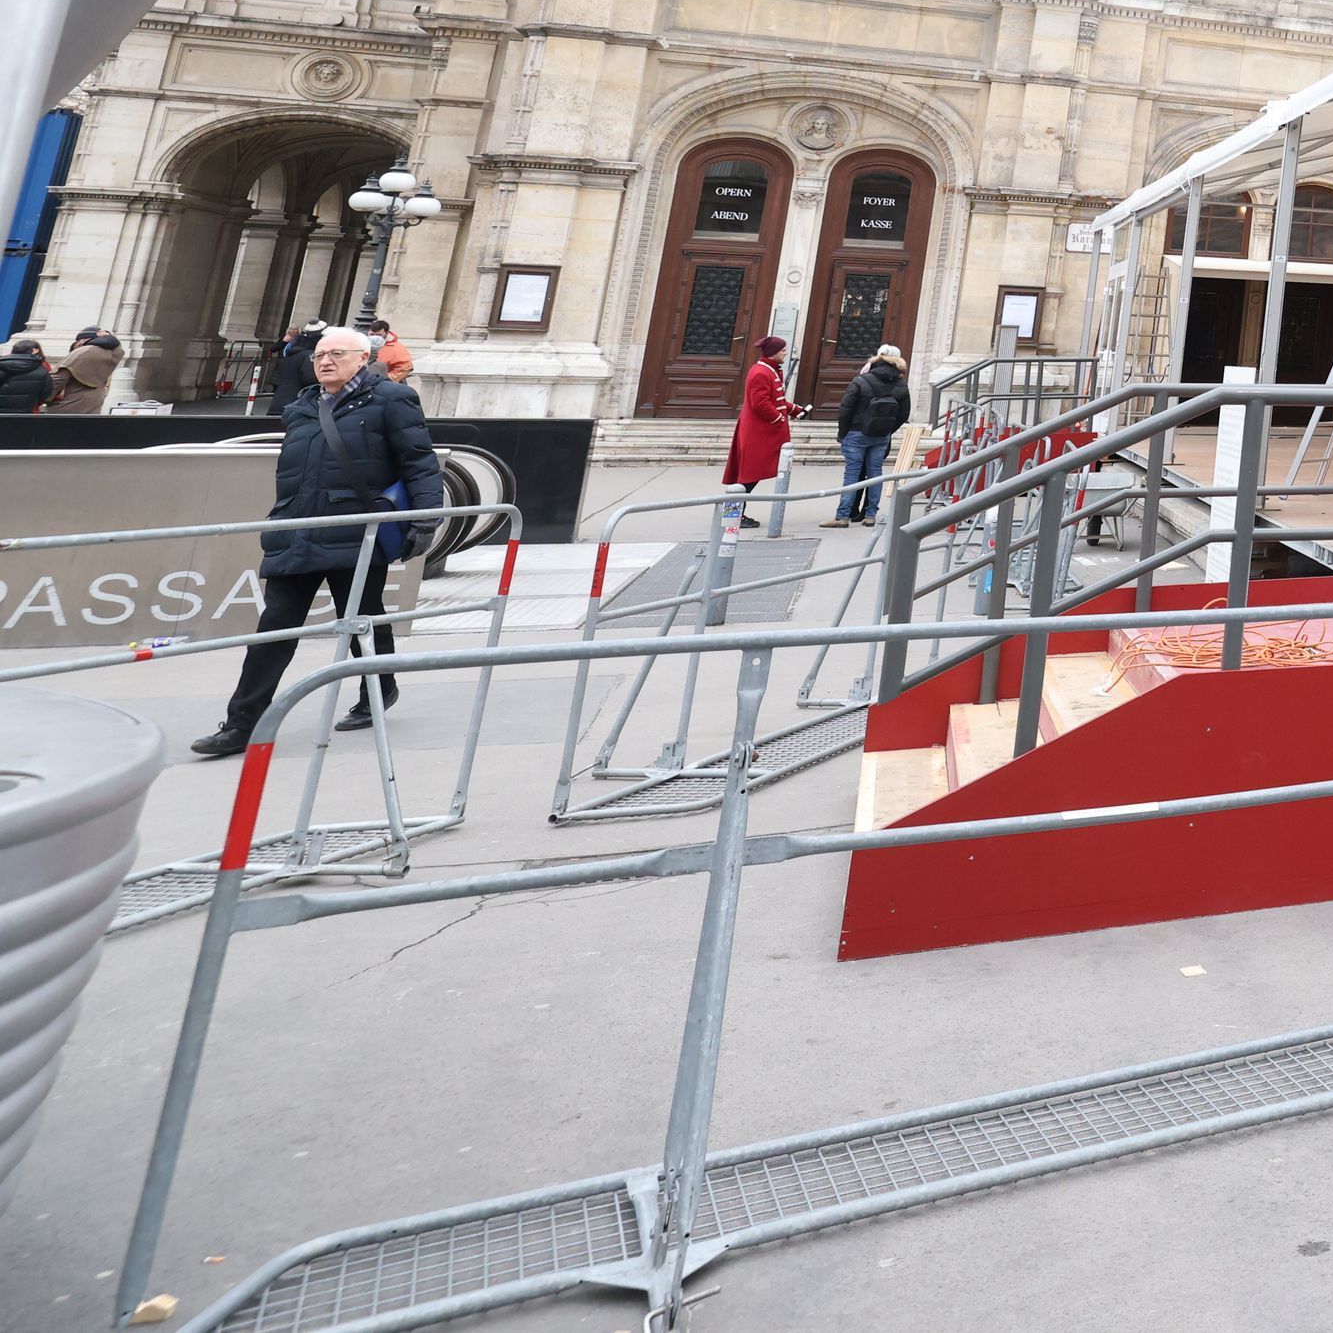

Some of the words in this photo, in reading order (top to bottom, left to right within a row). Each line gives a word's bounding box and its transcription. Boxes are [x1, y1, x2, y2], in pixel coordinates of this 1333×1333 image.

[715, 186, 752, 198] OPERN
[863, 196, 896, 207] FOYER
[710, 210, 749, 221] ABEND
[860, 218, 893, 229] KASSE
